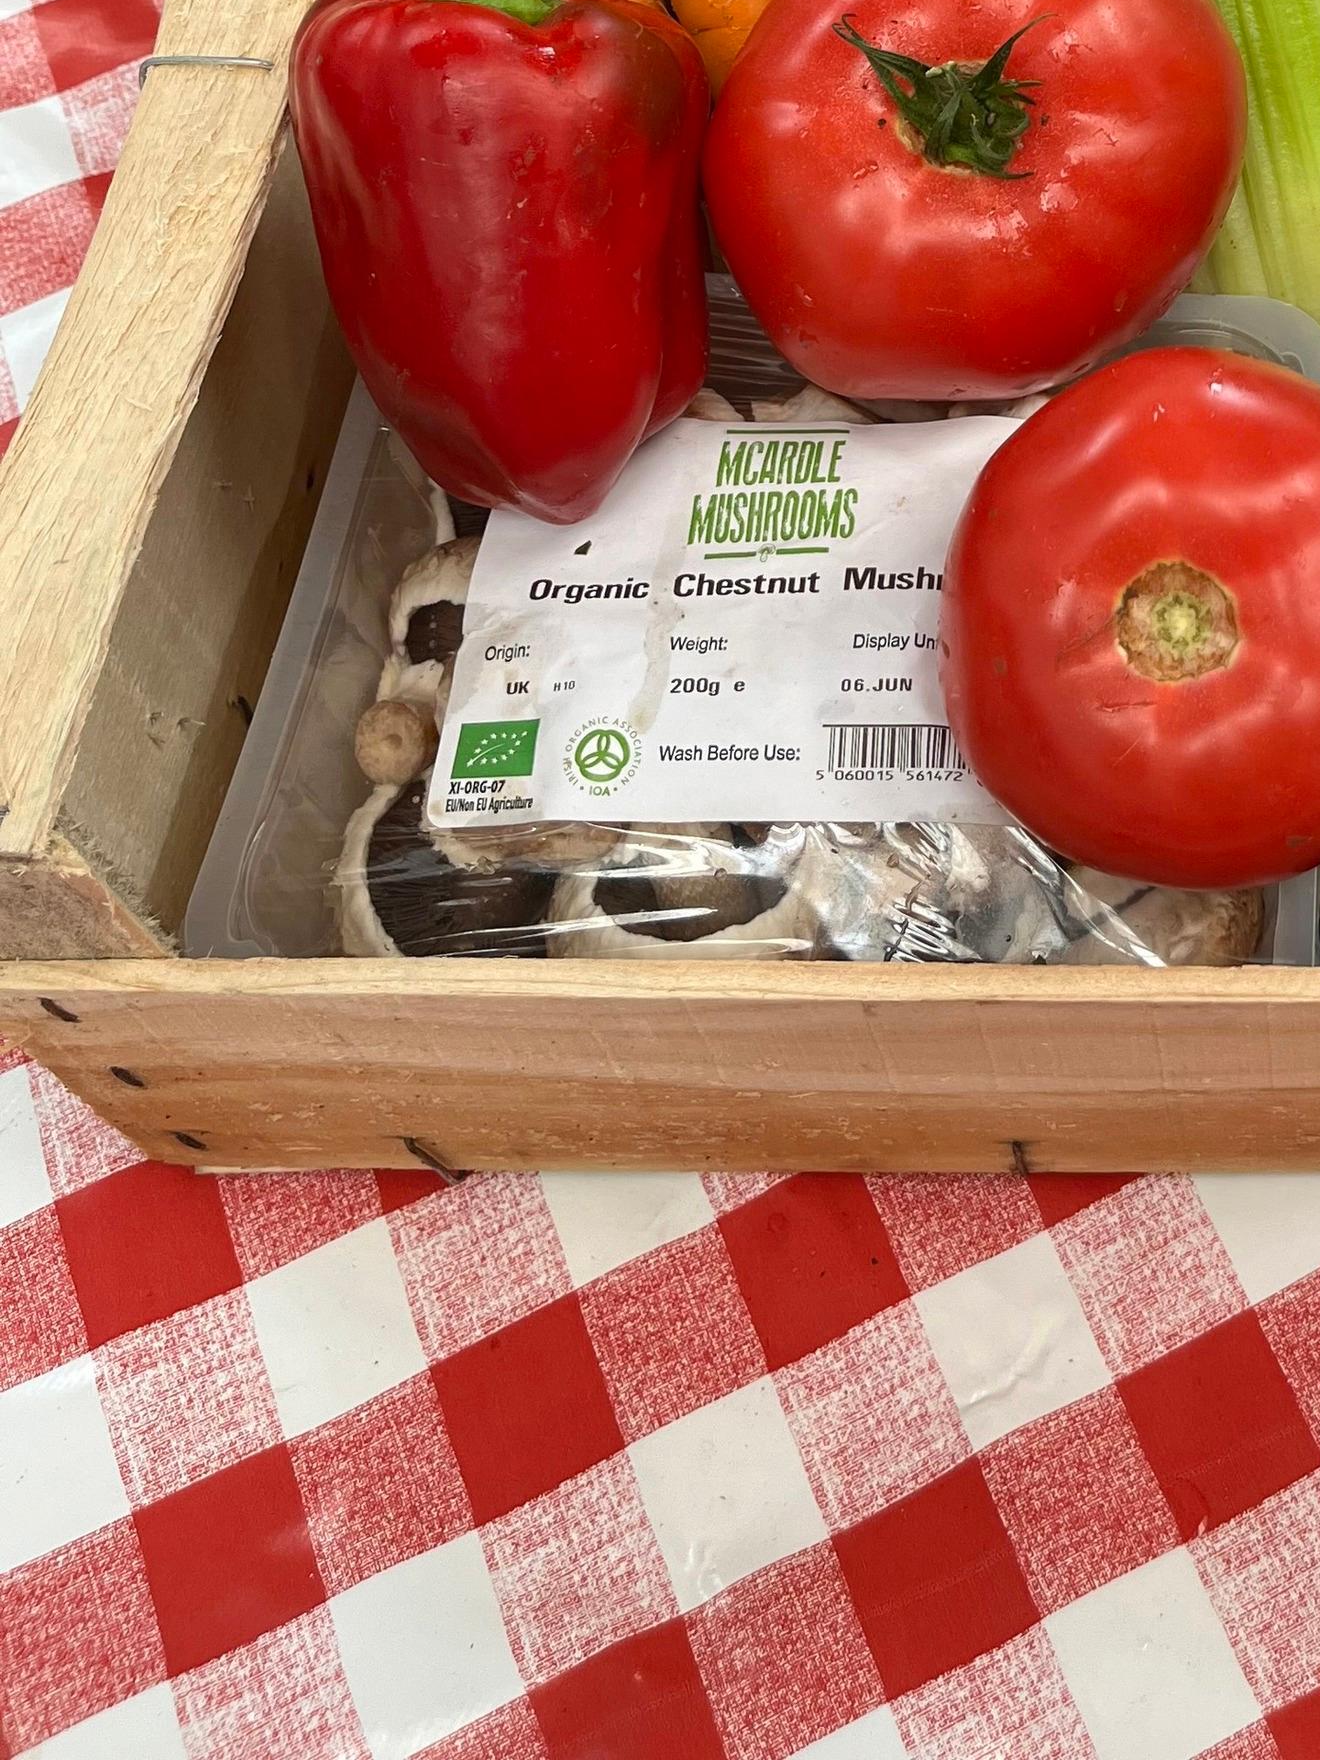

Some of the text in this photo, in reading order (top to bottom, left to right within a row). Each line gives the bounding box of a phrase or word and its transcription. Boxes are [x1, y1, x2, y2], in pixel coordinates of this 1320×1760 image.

[687, 488, 859, 545] MUSHROOMS
[529, 577, 650, 604] Organic
[673, 572, 821, 598] Chestnut
[669, 636, 729, 654] Weight:
[852, 632, 938, 651] Display Un
[484, 643, 531, 663] Origin:
[506, 680, 530, 695] UK
[669, 677, 746, 697] 200g e
[840, 677, 913, 692] 06.JUN
[565, 716, 609, 752] ORGANIC
[612, 717, 643, 786] ASSOCIATION
[659, 744, 801, 762] Wash Before Use:
[815, 769, 964, 782] 5 060015 561472
[448, 780, 506, 795] XI-ORG-07
[588, 785, 611, 797] IOA
[445, 795, 534, 814] EU/Non EU Agriculture
